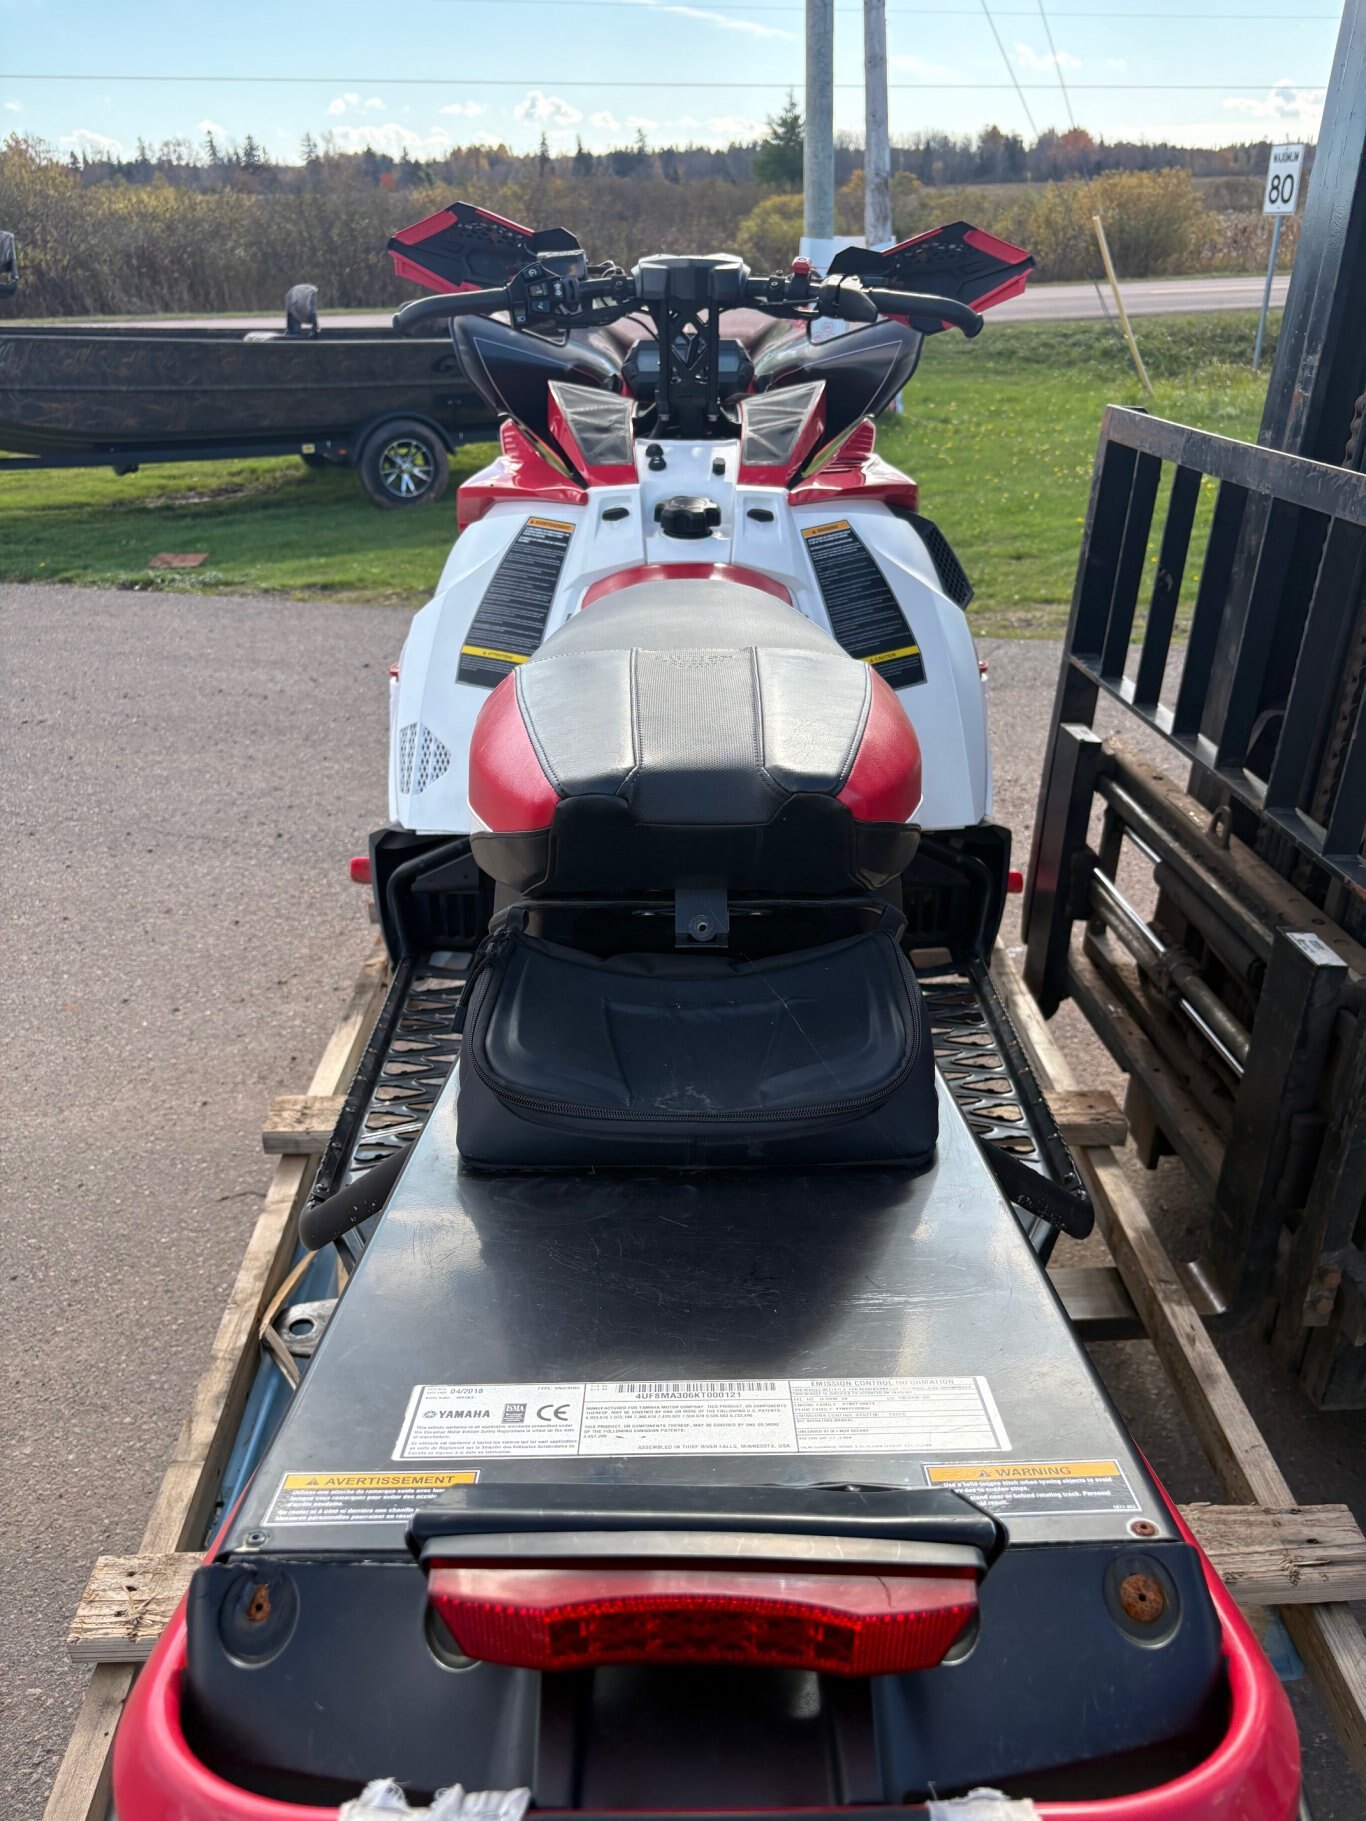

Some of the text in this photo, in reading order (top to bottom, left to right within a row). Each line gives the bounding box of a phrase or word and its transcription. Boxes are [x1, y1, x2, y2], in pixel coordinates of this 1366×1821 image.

[1268, 173, 1294, 204] 80
[505, 1404, 525, 1412] ISMA
[439, 1410, 491, 1419] YAMAHA
[994, 1466, 1072, 1478] WARNING
[324, 1476, 456, 1486] AVERTISSEMENT
